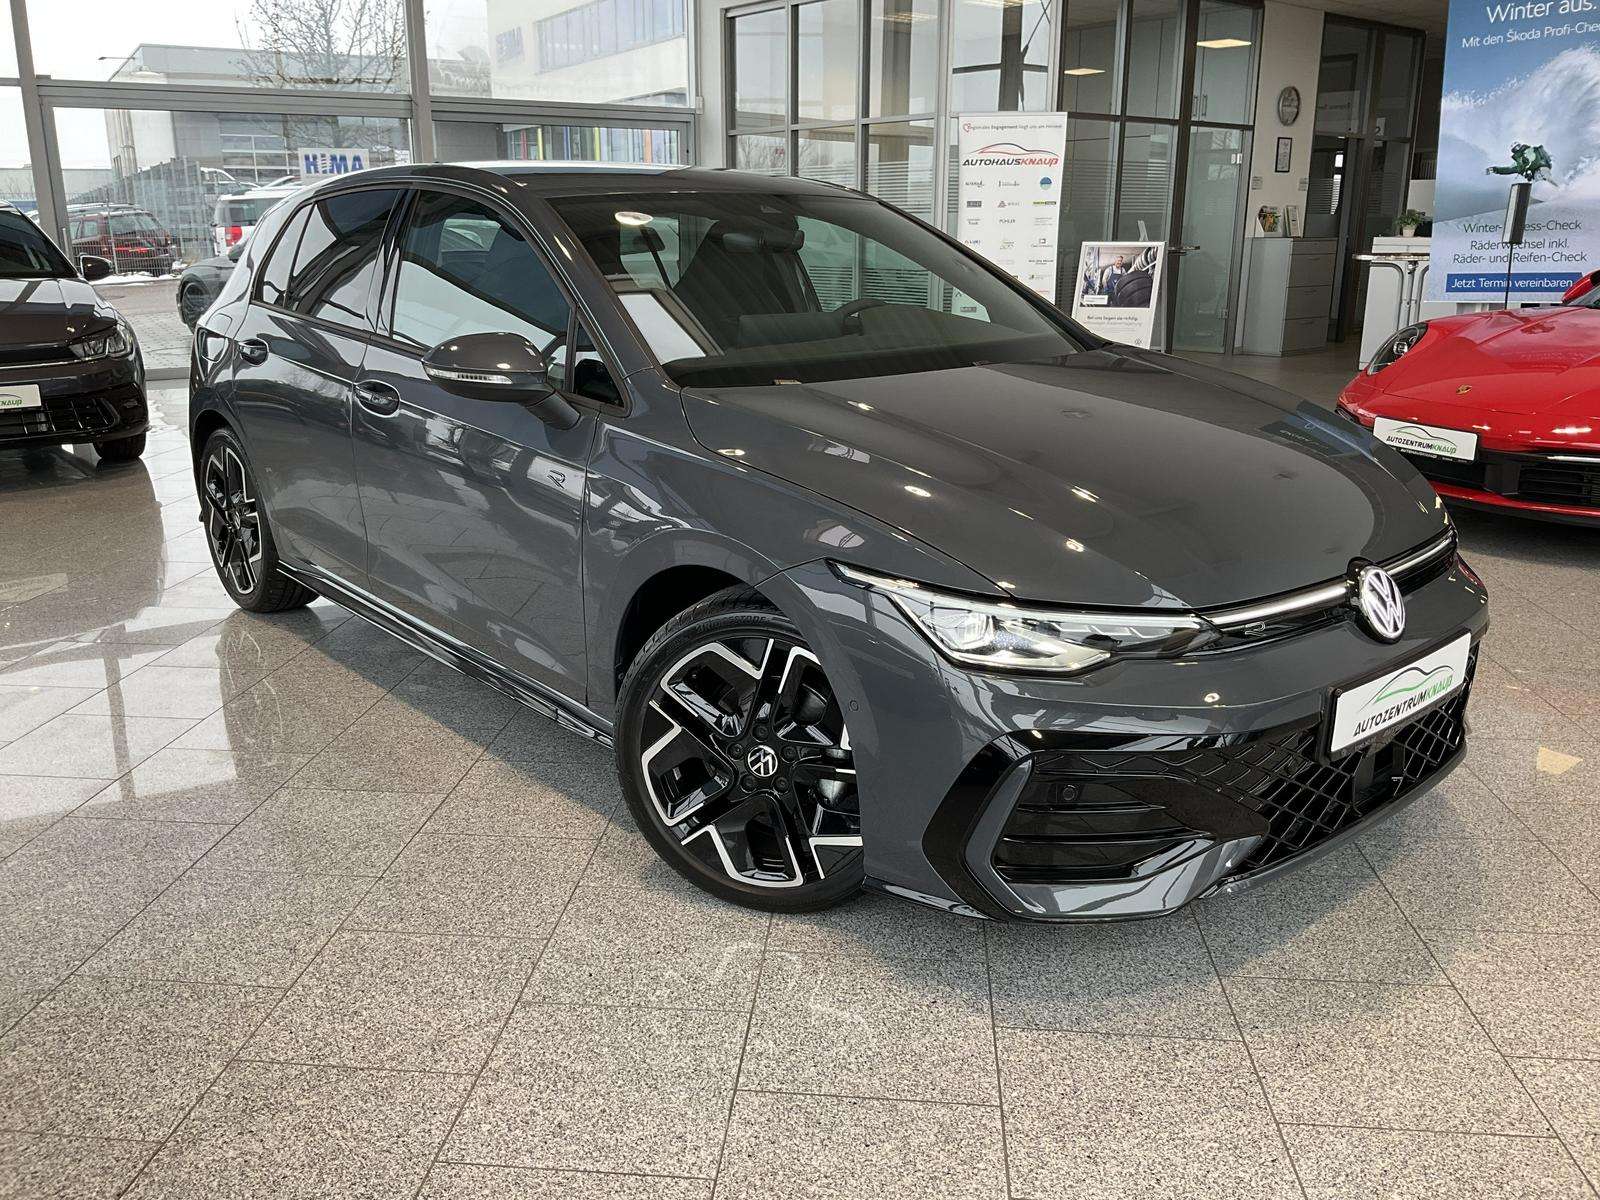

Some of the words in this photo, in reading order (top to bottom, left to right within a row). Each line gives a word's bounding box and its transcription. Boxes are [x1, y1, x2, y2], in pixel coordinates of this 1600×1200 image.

[1486, 2, 1554, 23] Winter
[1559, 0, 1597, 14] aus.
[1462, 35, 1482, 48] Mit
[1483, 34, 1503, 45] den
[1507, 28, 1541, 43] Škoda
[1544, 21, 1600, 38] Profi-Che
[1548, 238, 1570, 249] inkl.
[1453, 253, 1486, 264] Räder-
[1489, 253, 1508, 263] und
[1512, 251, 1588, 263] Reifen-Check
[1451, 278, 1476, 288] Jetzt
[1479, 278, 1512, 288] Termin
[1514, 277, 1574, 288] vereinbaren
[1353, 674, 1453, 737] AUTOZENTRUMKNAUP
